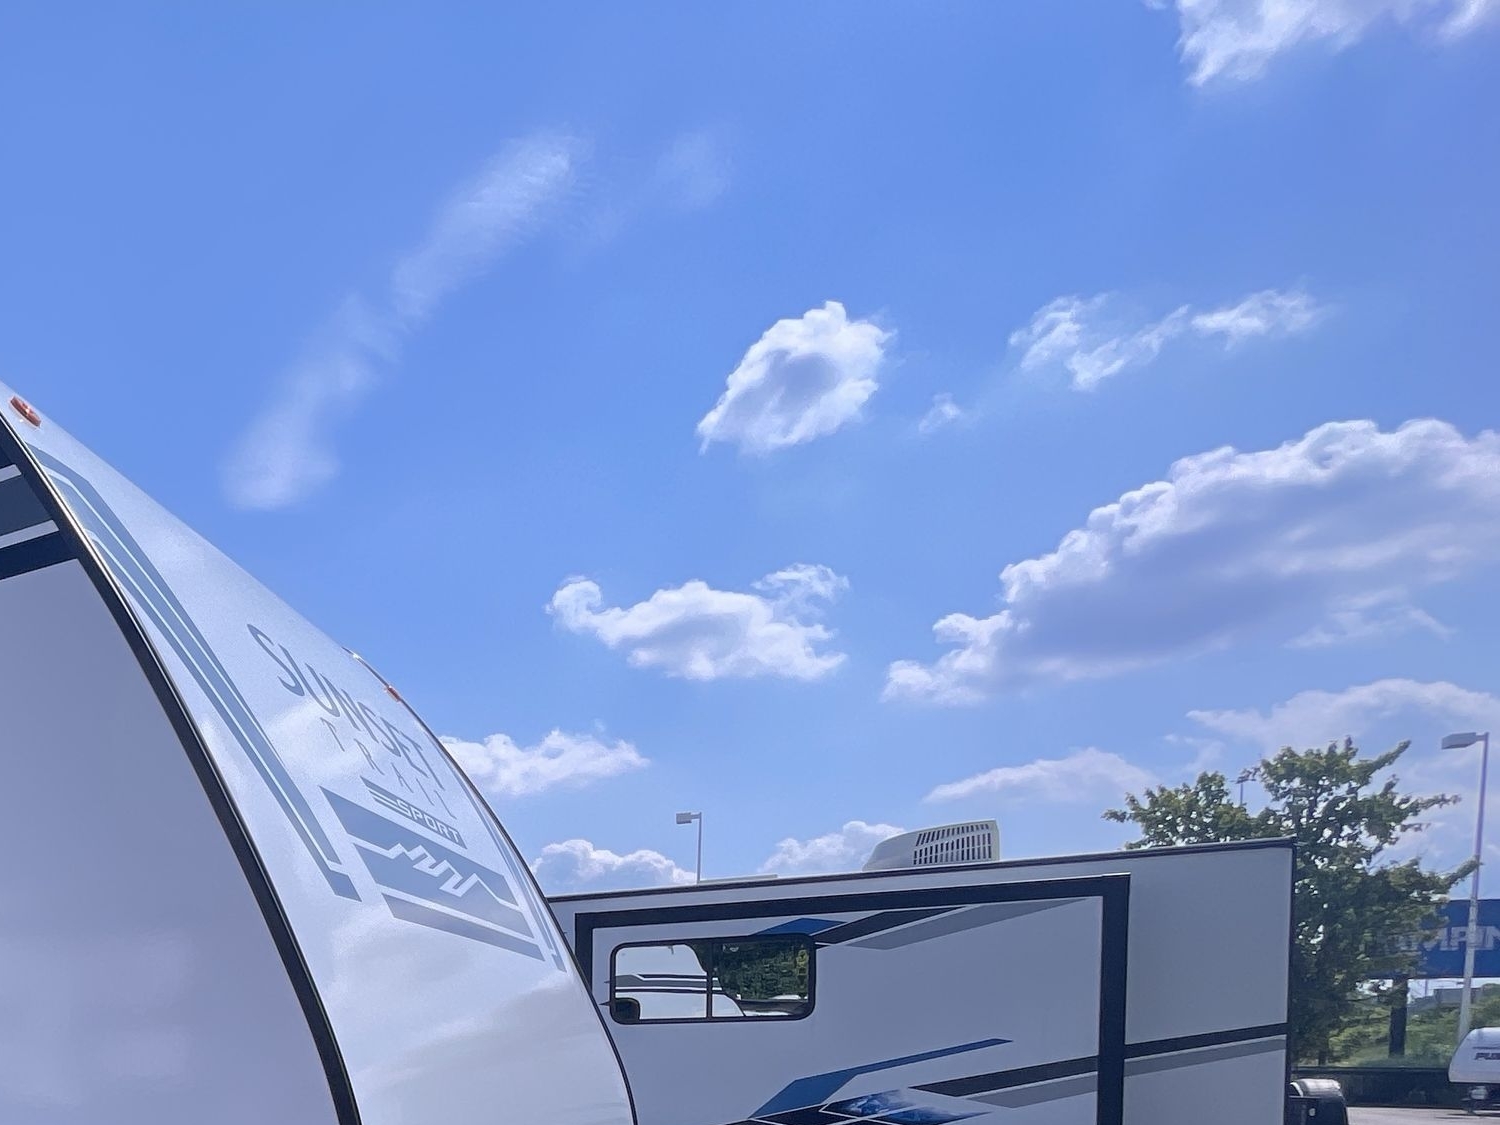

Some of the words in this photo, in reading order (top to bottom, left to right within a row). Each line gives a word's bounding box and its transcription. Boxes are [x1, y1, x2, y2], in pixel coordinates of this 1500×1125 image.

[247, 623, 445, 791] SUNSET
[320, 716, 457, 820] TRAIL
[392, 798, 461, 844] SPORT
